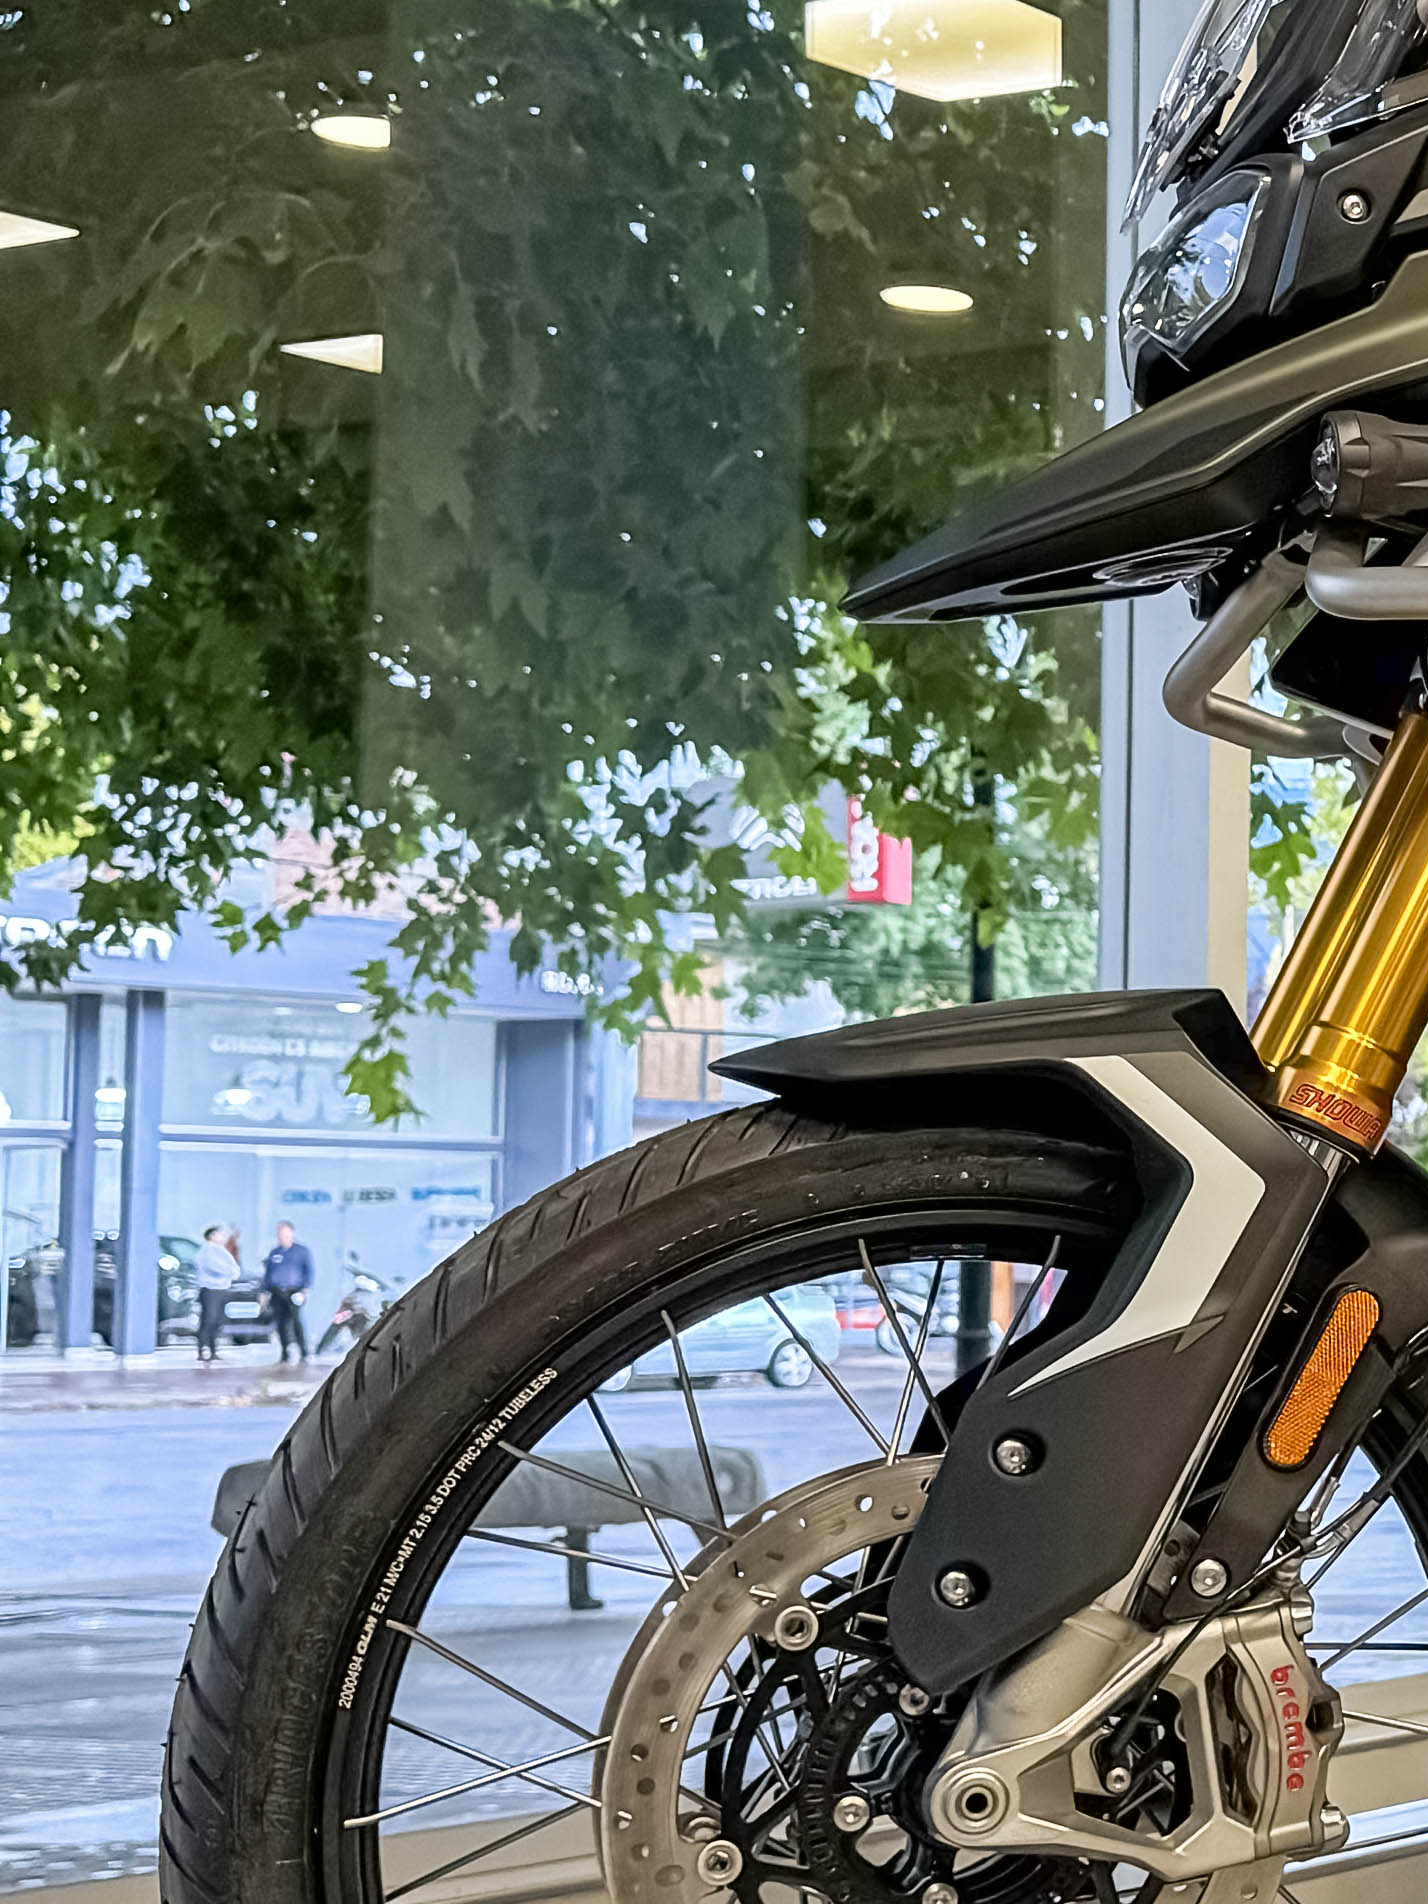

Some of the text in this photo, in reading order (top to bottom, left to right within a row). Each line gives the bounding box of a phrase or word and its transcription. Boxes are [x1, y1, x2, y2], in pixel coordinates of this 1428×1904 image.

[1289, 1083, 1382, 1141] SHOWA
[338, 1656, 364, 1709] 2000494
[370, 1601, 386, 1615] E
[379, 1586, 393, 1603] 21
[409, 1514, 432, 1539] 2.15
[424, 1495, 444, 1516] 3.5
[436, 1468, 462, 1497] DOT
[455, 1445, 481, 1473] PRC
[498, 1367, 558, 1420] TUBELESS
[1270, 1664, 1312, 1792] brembo
